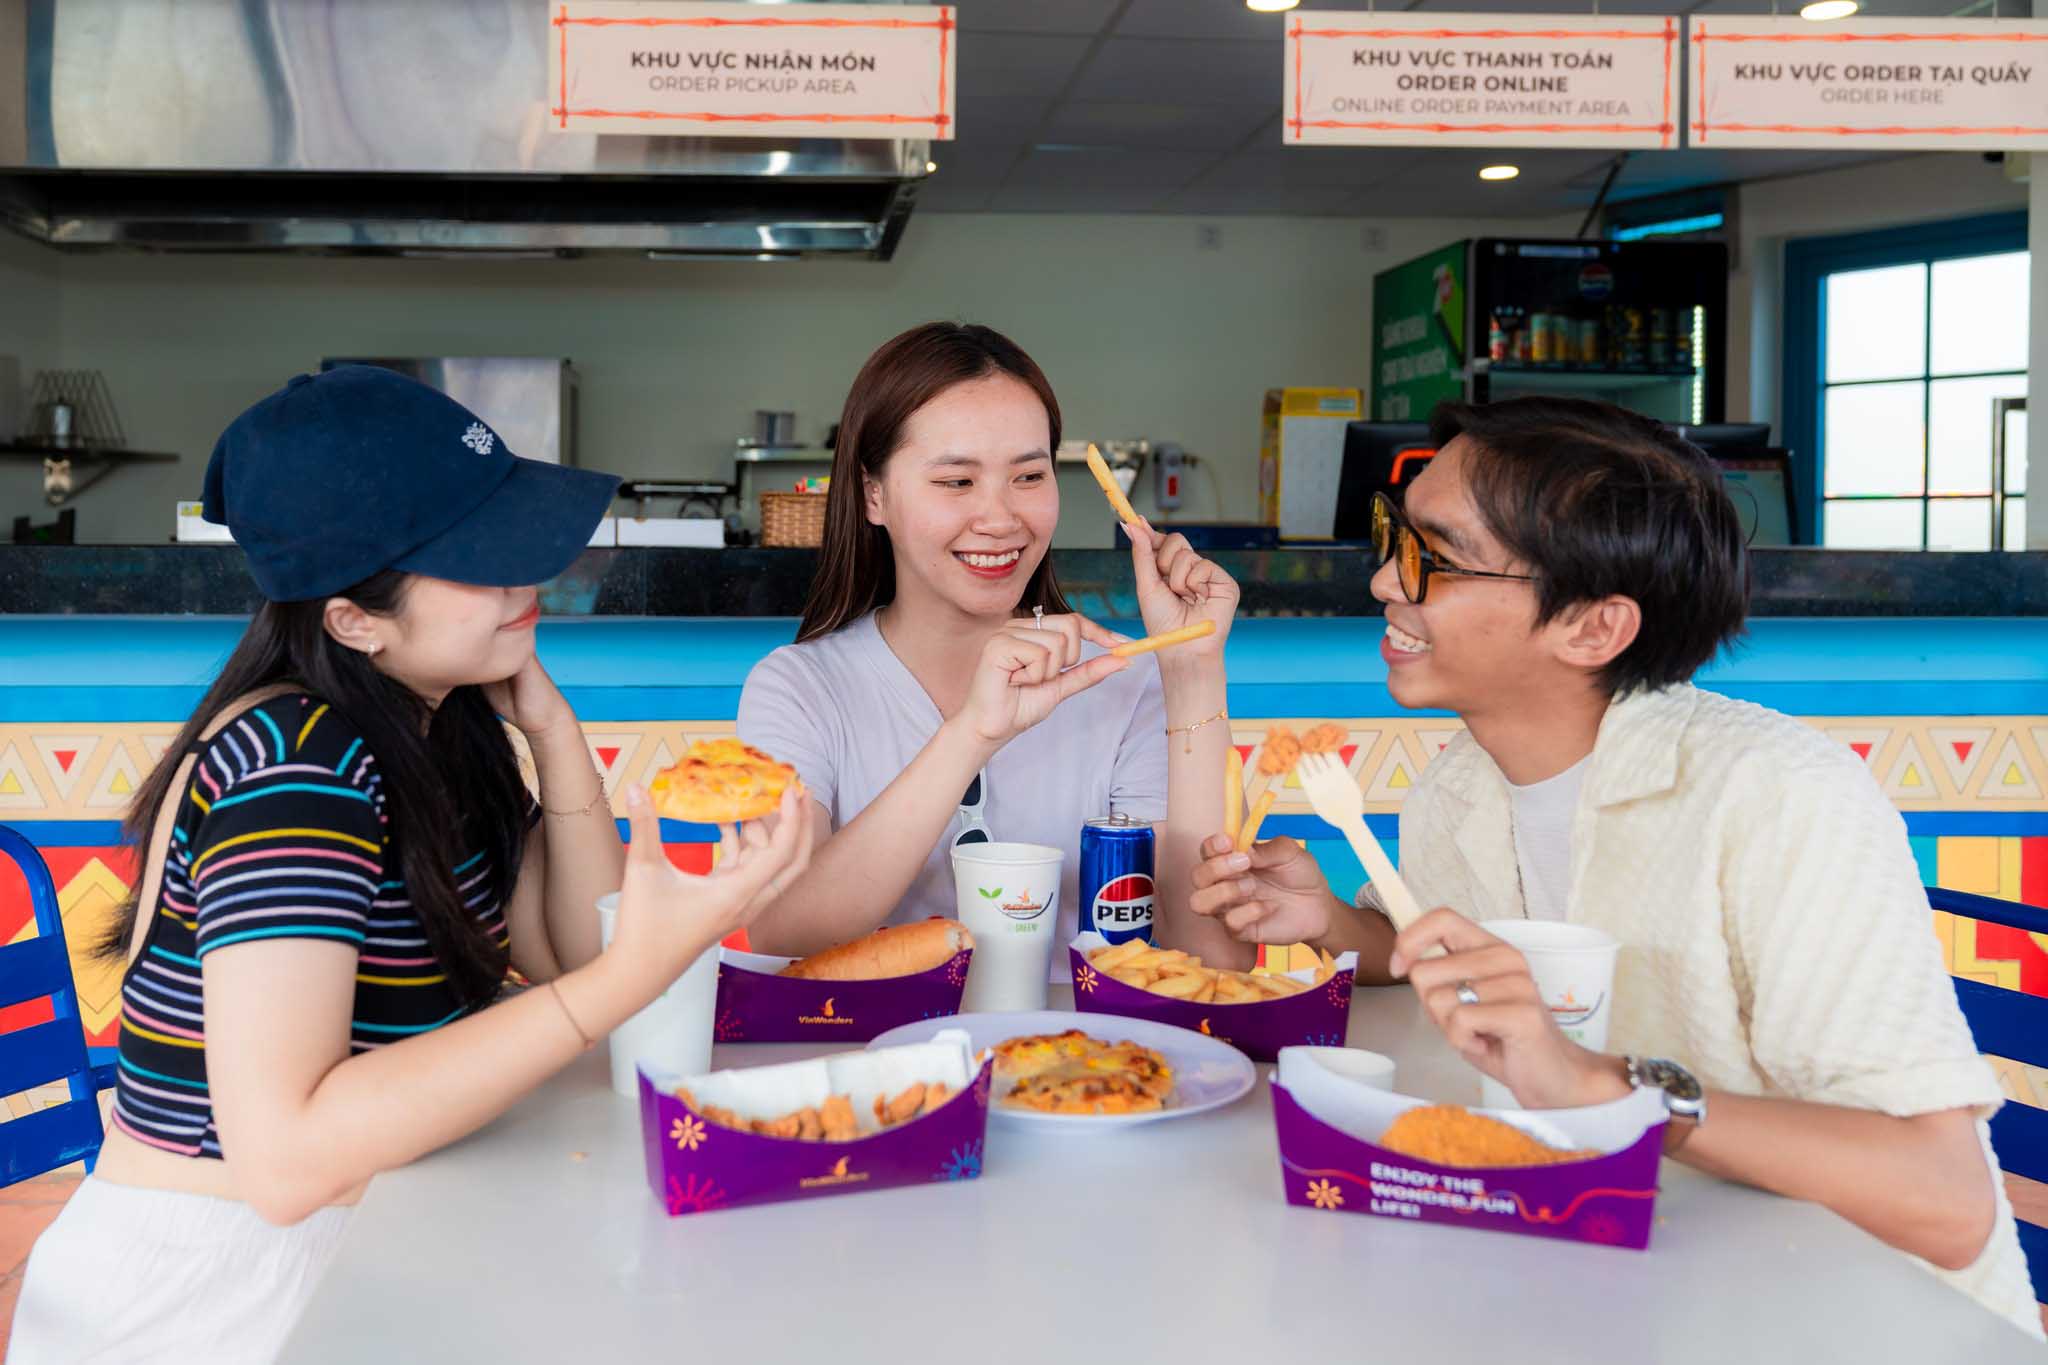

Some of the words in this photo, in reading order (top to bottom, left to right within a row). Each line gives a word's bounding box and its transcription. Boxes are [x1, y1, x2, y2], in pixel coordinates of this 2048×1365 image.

[631, 51, 680, 68] KHU
[688, 50, 737, 73] VỰC
[745, 49, 813, 74] NHẬN
[821, 49, 876, 71] MÓN
[1352, 49, 1401, 67] KHU
[1408, 49, 1456, 71] VỰC
[1464, 51, 1543, 68] THANH
[1550, 48, 1613, 69] TOÁN
[648, 75, 720, 92] ORDER
[725, 76, 798, 93] PICKUP
[803, 78, 857, 94] AREA
[1396, 74, 1477, 92] ORDER
[1484, 75, 1568, 93] ONLINE
[1734, 64, 1782, 80] KHU
[1789, 62, 1836, 86] VỰC
[1843, 65, 1921, 82] ORDER
[1929, 65, 1963, 87] TẠI
[1331, 96, 1405, 114] ONLINE
[1410, 97, 1480, 114] ORDER
[1485, 98, 1571, 115] PAYMENT
[1577, 99, 1631, 117] AREA
[1820, 87, 1889, 105] ORDER
[1893, 88, 1944, 105] HERE
[1097, 903, 1153, 922] PEPS
[1370, 1161, 1439, 1188] ENJOY
[1440, 1174, 1485, 1195] THE
